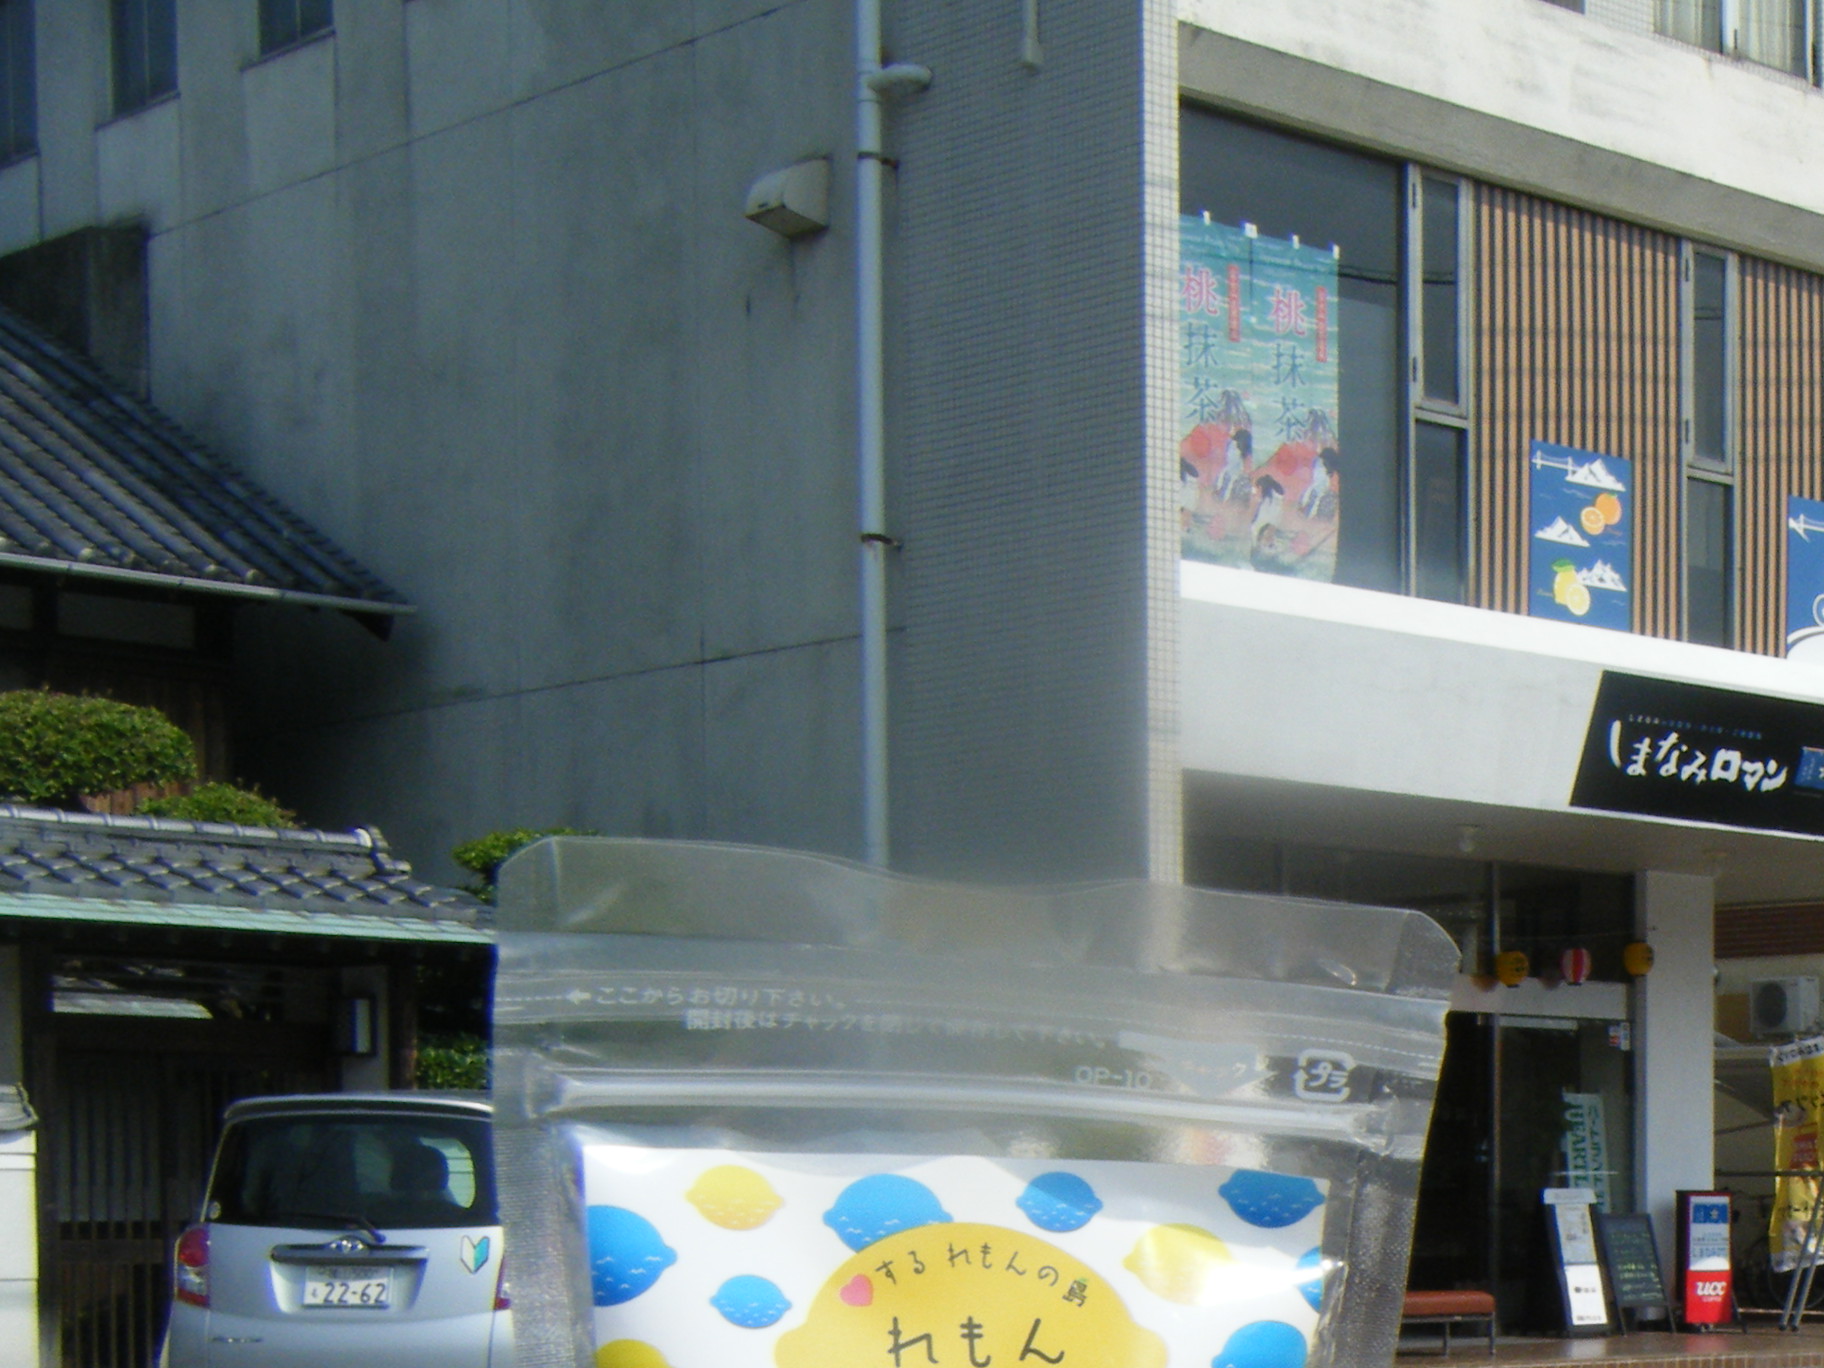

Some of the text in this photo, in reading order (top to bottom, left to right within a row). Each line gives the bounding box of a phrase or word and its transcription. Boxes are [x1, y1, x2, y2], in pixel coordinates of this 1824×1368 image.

[1182, 265, 1219, 424] 桃抹茶
[1271, 285, 1308, 442] 桃抹茶
[1609, 718, 1789, 793] しまなみロマン
[323, 1281, 386, 1304] 22-62
[1696, 1281, 1728, 1297] UCC
[887, 1315, 1065, 1368] れもん
